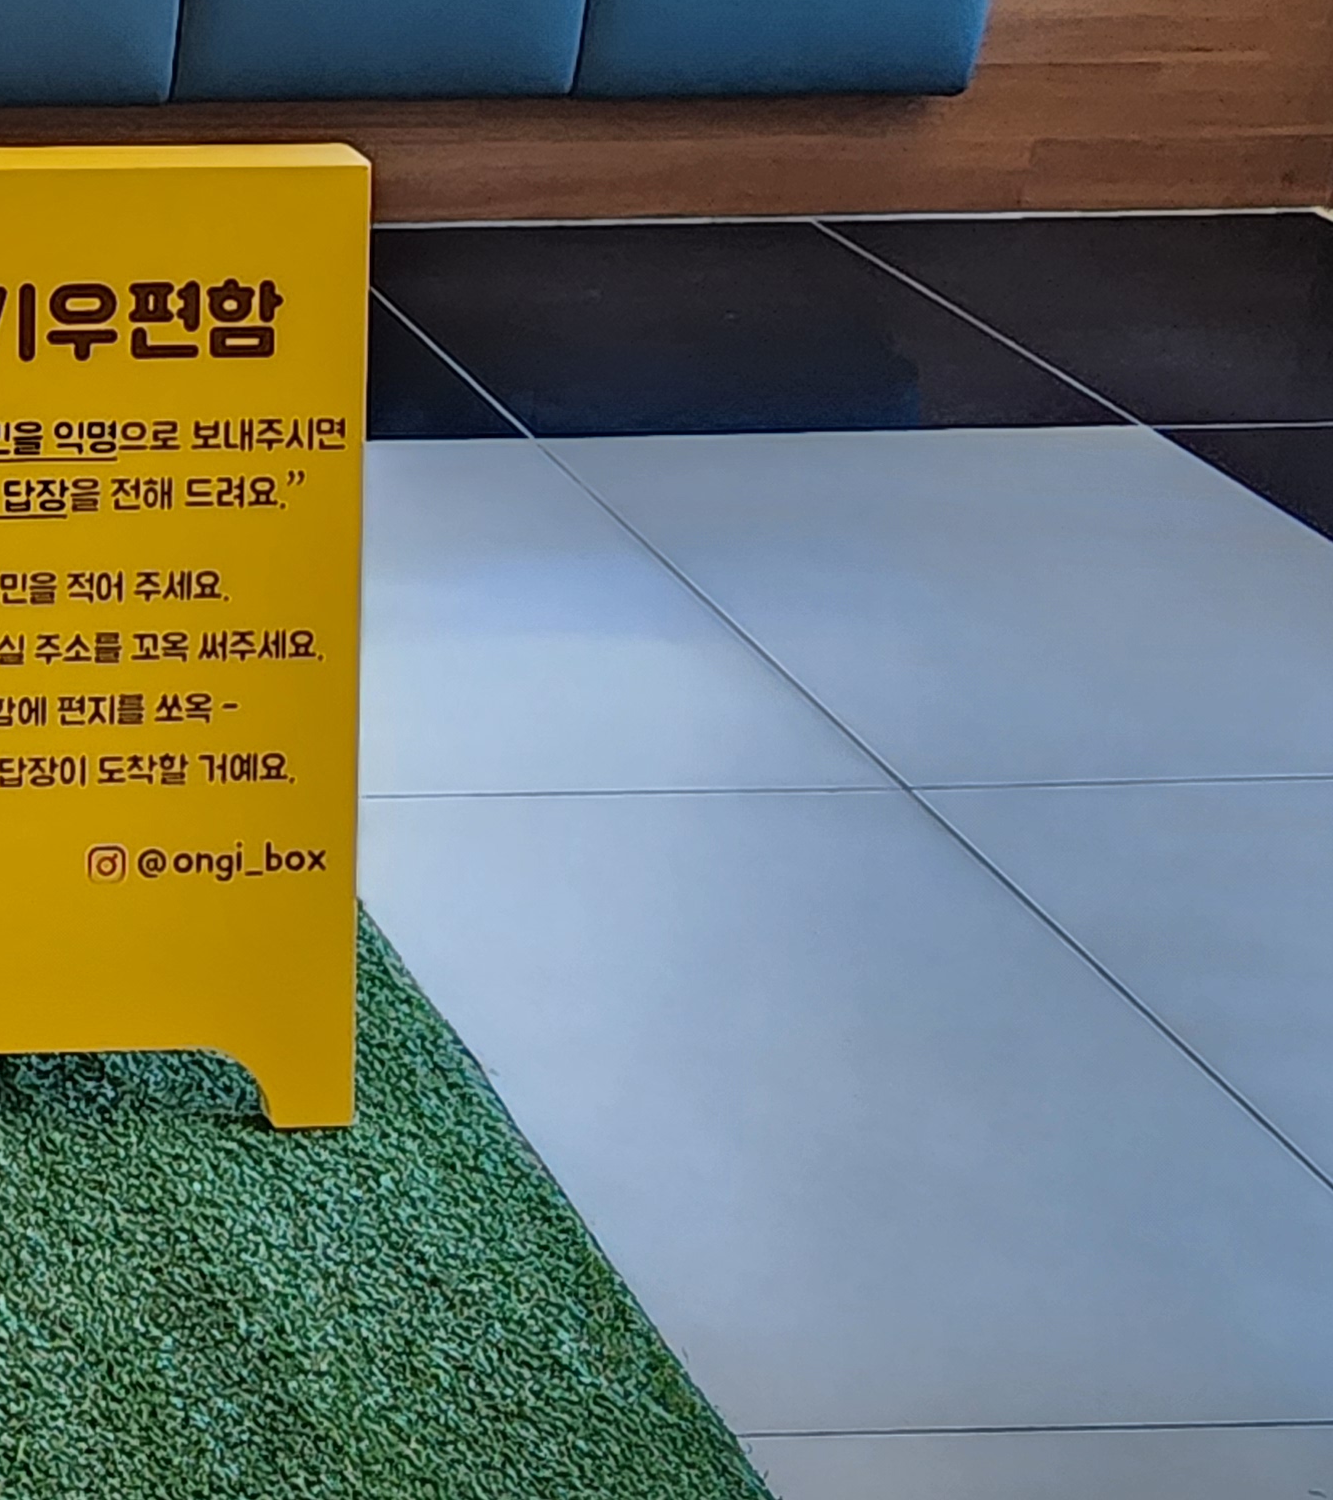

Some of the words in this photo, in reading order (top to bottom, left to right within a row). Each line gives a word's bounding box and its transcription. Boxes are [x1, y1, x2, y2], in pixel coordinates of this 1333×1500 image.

[52, 418, 182, 455] 익명으로
[191, 417, 347, 453] 보내주시면
[2, 476, 100, 514] 답장을
[110, 476, 174, 513] 전해
[66, 570, 125, 603] 적어
[134, 569, 230, 605] 주세요.
[34, 631, 123, 665] 주소를
[130, 631, 189, 663] 꼬옥
[198, 629, 325, 663] 써주세요.
[57, 694, 145, 727] 편지를
[97, 753, 188, 786] 도착할
[199, 752, 296, 785] 거예요.
[136, 841, 327, 881] @ongi_box
